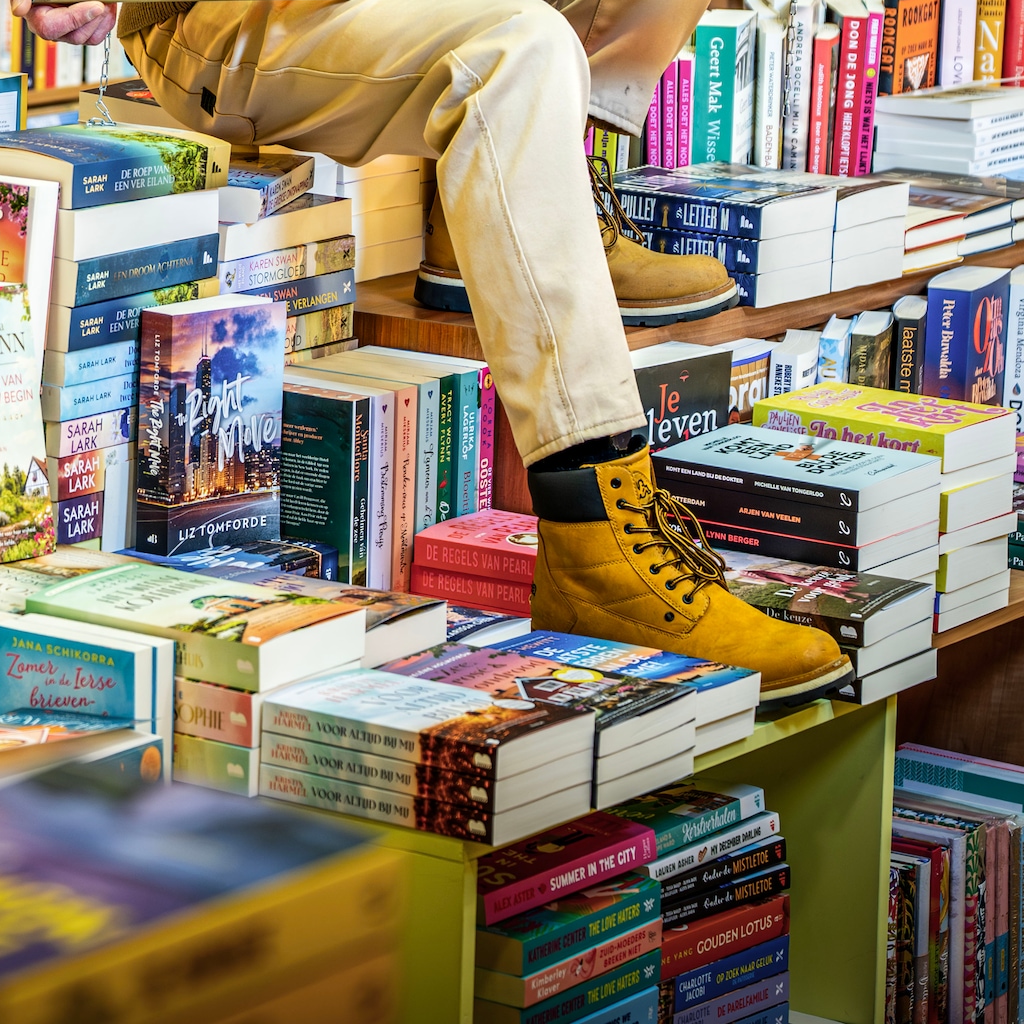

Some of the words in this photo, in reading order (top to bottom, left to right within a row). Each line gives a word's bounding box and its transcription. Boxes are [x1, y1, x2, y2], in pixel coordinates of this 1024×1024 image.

[902, 0, 939, 27] ROOKGAT
[978, 7, 1003, 17] Fanto
[795, 21, 804, 62] ANDREA
[849, 20, 860, 49] DON
[881, 7, 897, 74] ROOKGAT
[710, 37, 725, 78] Geert
[847, 53, 857, 70] DE
[707, 79, 723, 114] Mak
[793, 67, 802, 107] BOCELLI
[843, 74, 856, 109] JONG
[791, 111, 800, 134] MIJN
[621, 194, 657, 222] PULLEY
[683, 203, 719, 230] LETTER
[720, 207, 730, 232] M
[248, 264, 305, 286] STORMGLOED
[293, 291, 338, 310] VERLANGEN
[941, 299, 956, 328] Peter
[901, 327, 917, 378] laatste
[939, 330, 954, 379] Buwalda
[1, 373, 23, 387] VAN
[4, 389, 34, 405] BEGIN
[655, 383, 681, 424] Je
[67, 419, 103, 439] SARAH
[647, 407, 718, 446] leven
[769, 411, 801, 426] PAULIEN
[70, 435, 98, 454] LARK
[219, 414, 276, 472] Move
[354, 414, 363, 483] Montefiore
[809, 420, 837, 440] In
[840, 426, 871, 446] het
[873, 430, 920, 453] kort
[63, 456, 100, 478] SARAH
[69, 474, 95, 493] LARK
[754, 481, 779, 490] MICHELLE
[792, 487, 824, 498] TONGERLOO
[63, 501, 99, 523] SARAH
[739, 507, 760, 517] ARJEN
[761, 510, 775, 519] VAN
[776, 513, 801, 524] VEELEN
[68, 518, 95, 538] LARK
[179, 526, 199, 541] LIZ
[201, 515, 267, 537] TOMFORDE
[705, 530, 726, 541] LYNN
[728, 533, 760, 547] BERGER
[427, 544, 438, 561] DE
[442, 547, 478, 568] REGELS
[481, 553, 501, 570] VAN
[502, 555, 533, 576] PEARL
[422, 571, 434, 589] DE
[438, 574, 473, 595] REGELS
[477, 580, 496, 597] VAN
[497, 582, 526, 604] PEARL
[766, 607, 780, 618] De
[784, 610, 812, 624] keuze
[12, 637, 43, 653] JANA
[46, 645, 115, 667] SCHIKORRA
[6, 653, 59, 679] Zomer
[30, 686, 96, 709] brieven-
[682, 807, 736, 843] Kerstverhalen
[550, 868, 585, 891] SUMMER
[587, 864, 597, 877] IN
[599, 858, 615, 873] THE
[617, 847, 637, 869] CITY
[655, 862, 676, 878] LAUREN
[677, 855, 695, 870] ASHER
[527, 936, 562, 963] KATHERINE
[562, 927, 586, 948] CENTER
[589, 920, 600, 937] THE
[601, 913, 616, 932] LOVE
[617, 903, 640, 924] HATERS
[599, 931, 646, 958] ZUID-MOEDERS
[674, 948, 693, 960] YANG
[696, 928, 738, 955] GOUDEN
[740, 915, 773, 938] LOTUS
[531, 968, 567, 990] Kimberley
[537, 982, 560, 999] Klaver
[679, 972, 712, 993] CHARLOTTE
[561, 994, 585, 1016] CENTER
[587, 987, 598, 1004] THE
[600, 979, 616, 999] LOVE
[617, 970, 640, 991] HATERS
[685, 986, 706, 1002] JACOBI
